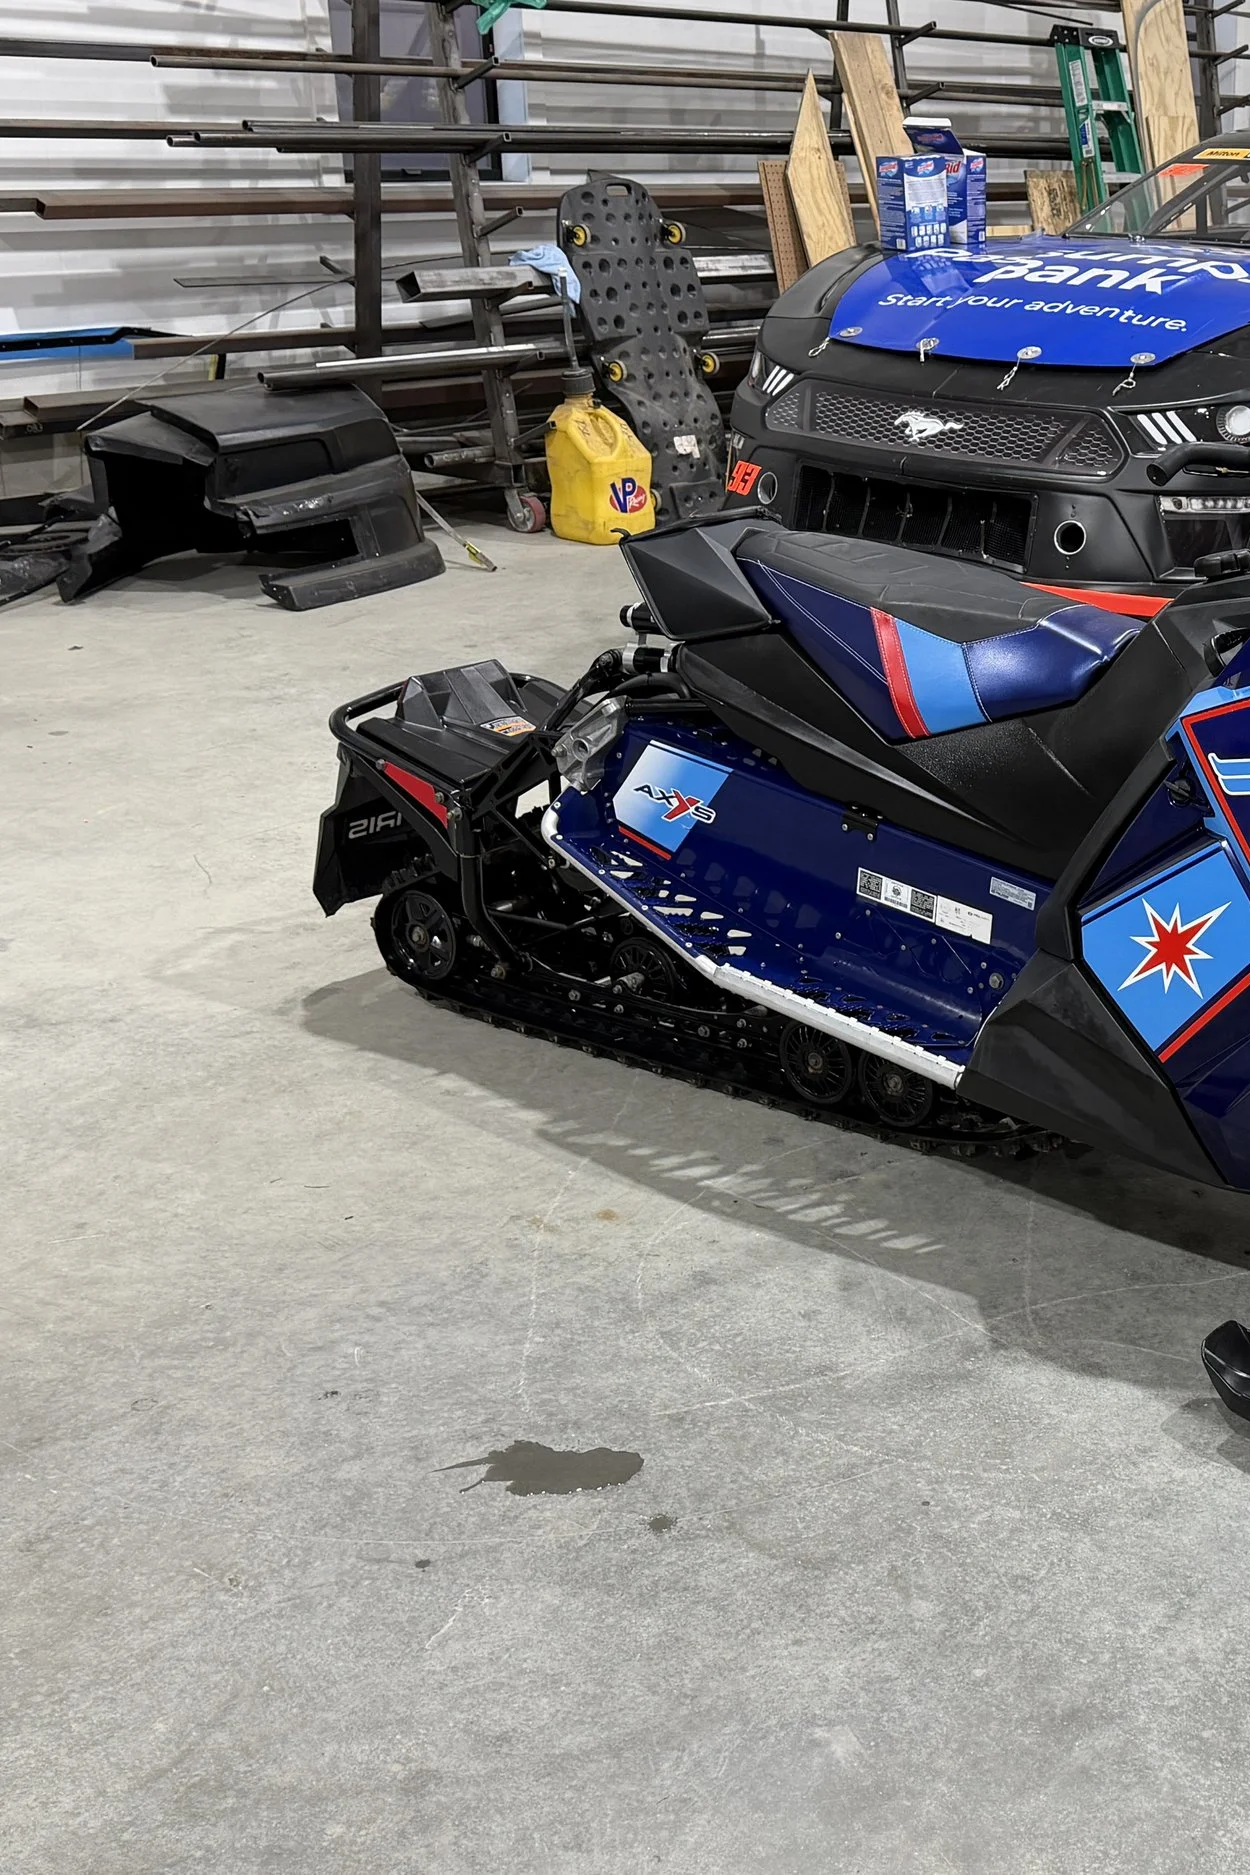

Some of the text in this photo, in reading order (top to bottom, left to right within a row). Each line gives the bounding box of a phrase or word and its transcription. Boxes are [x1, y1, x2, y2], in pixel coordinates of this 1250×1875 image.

[878, 293, 1188, 332] Start your adventure.
[609, 477, 637, 513] VP
[727, 460, 762, 495] 93
[634, 783, 716, 824] AXYS
